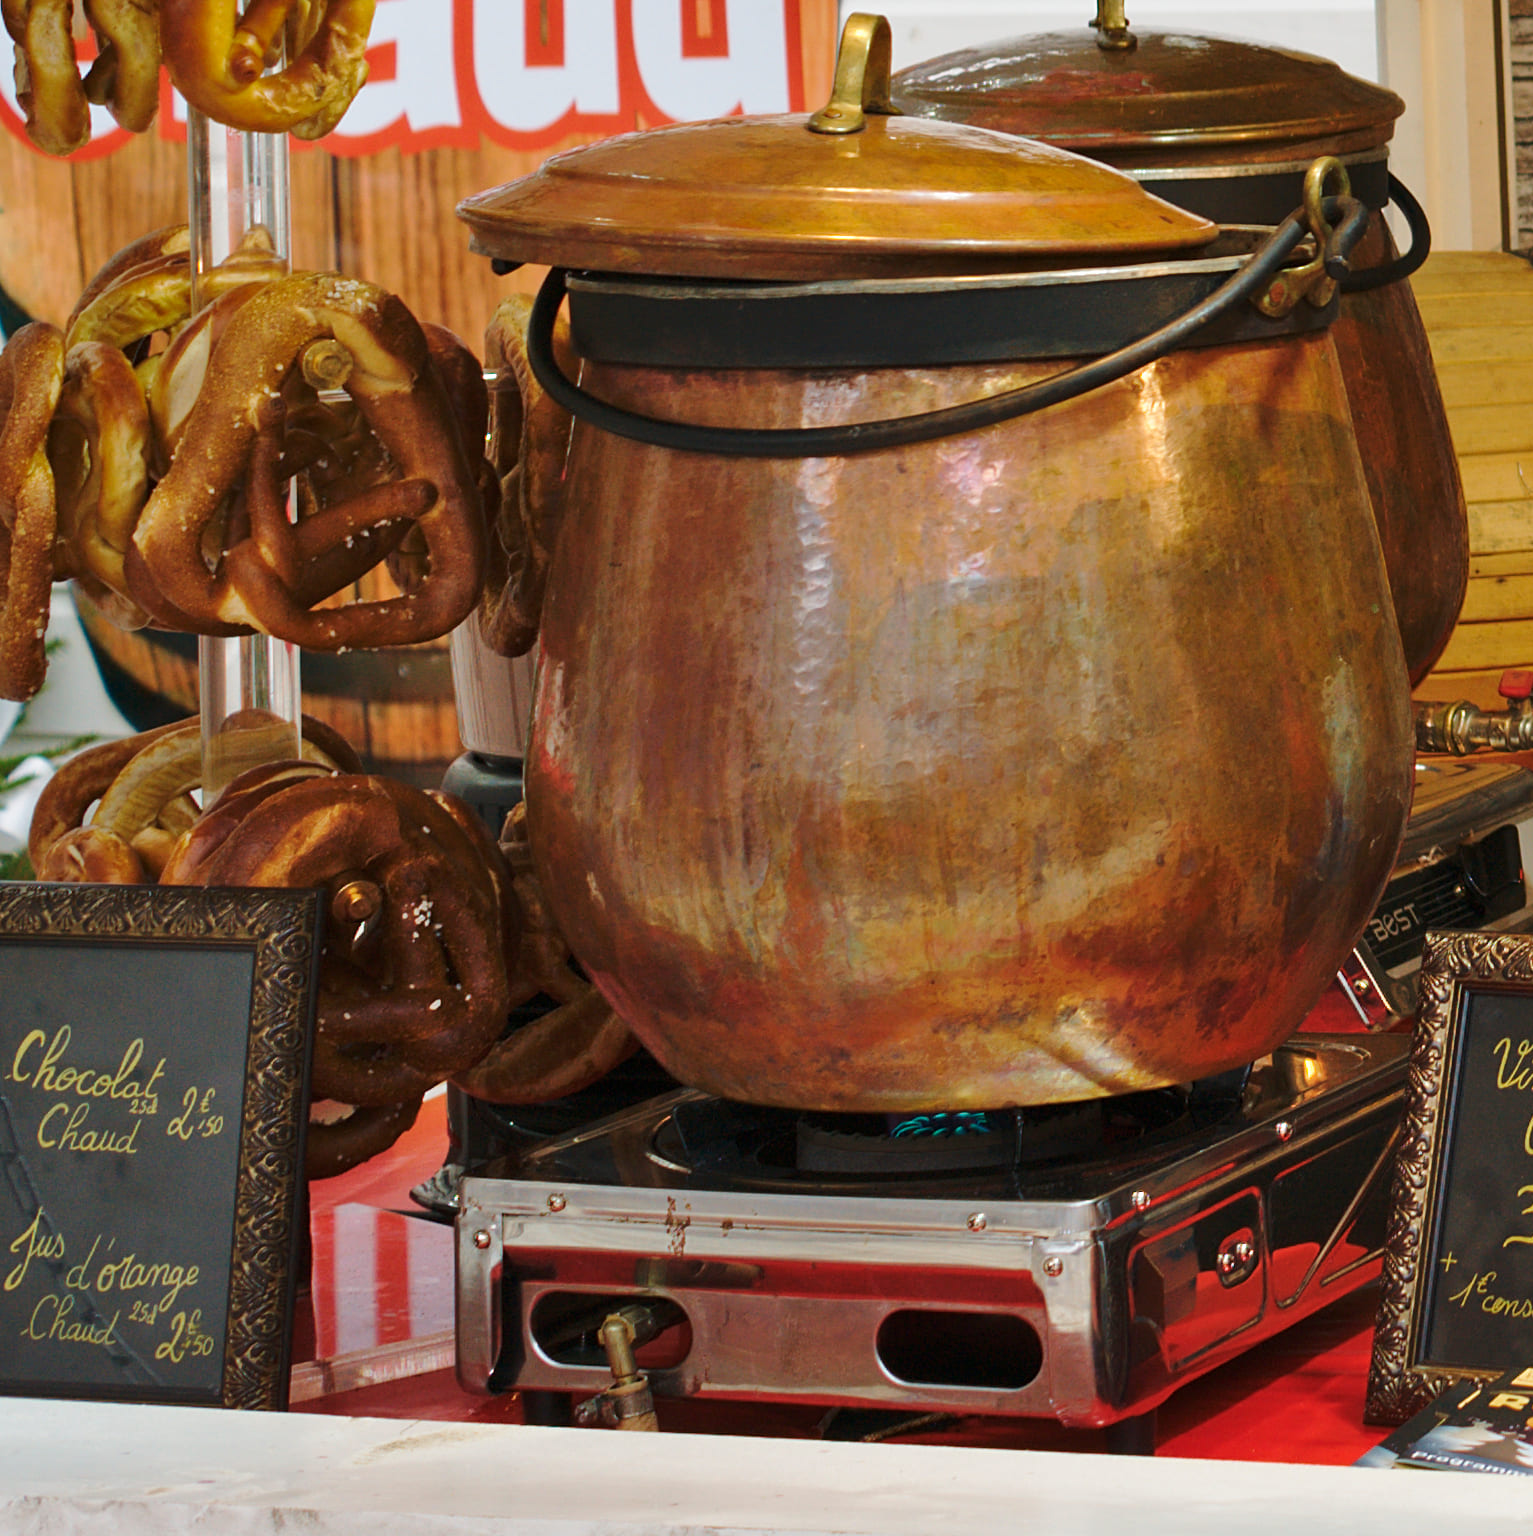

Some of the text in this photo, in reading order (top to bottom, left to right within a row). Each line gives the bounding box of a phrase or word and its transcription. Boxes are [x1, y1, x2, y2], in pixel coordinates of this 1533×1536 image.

[8, 1024, 167, 1099] Chocolat
[37, 1101, 142, 1154] Chaud
[3, 1205, 200, 1313] Jus d'orange
[20, 1294, 121, 1346] Chaud
